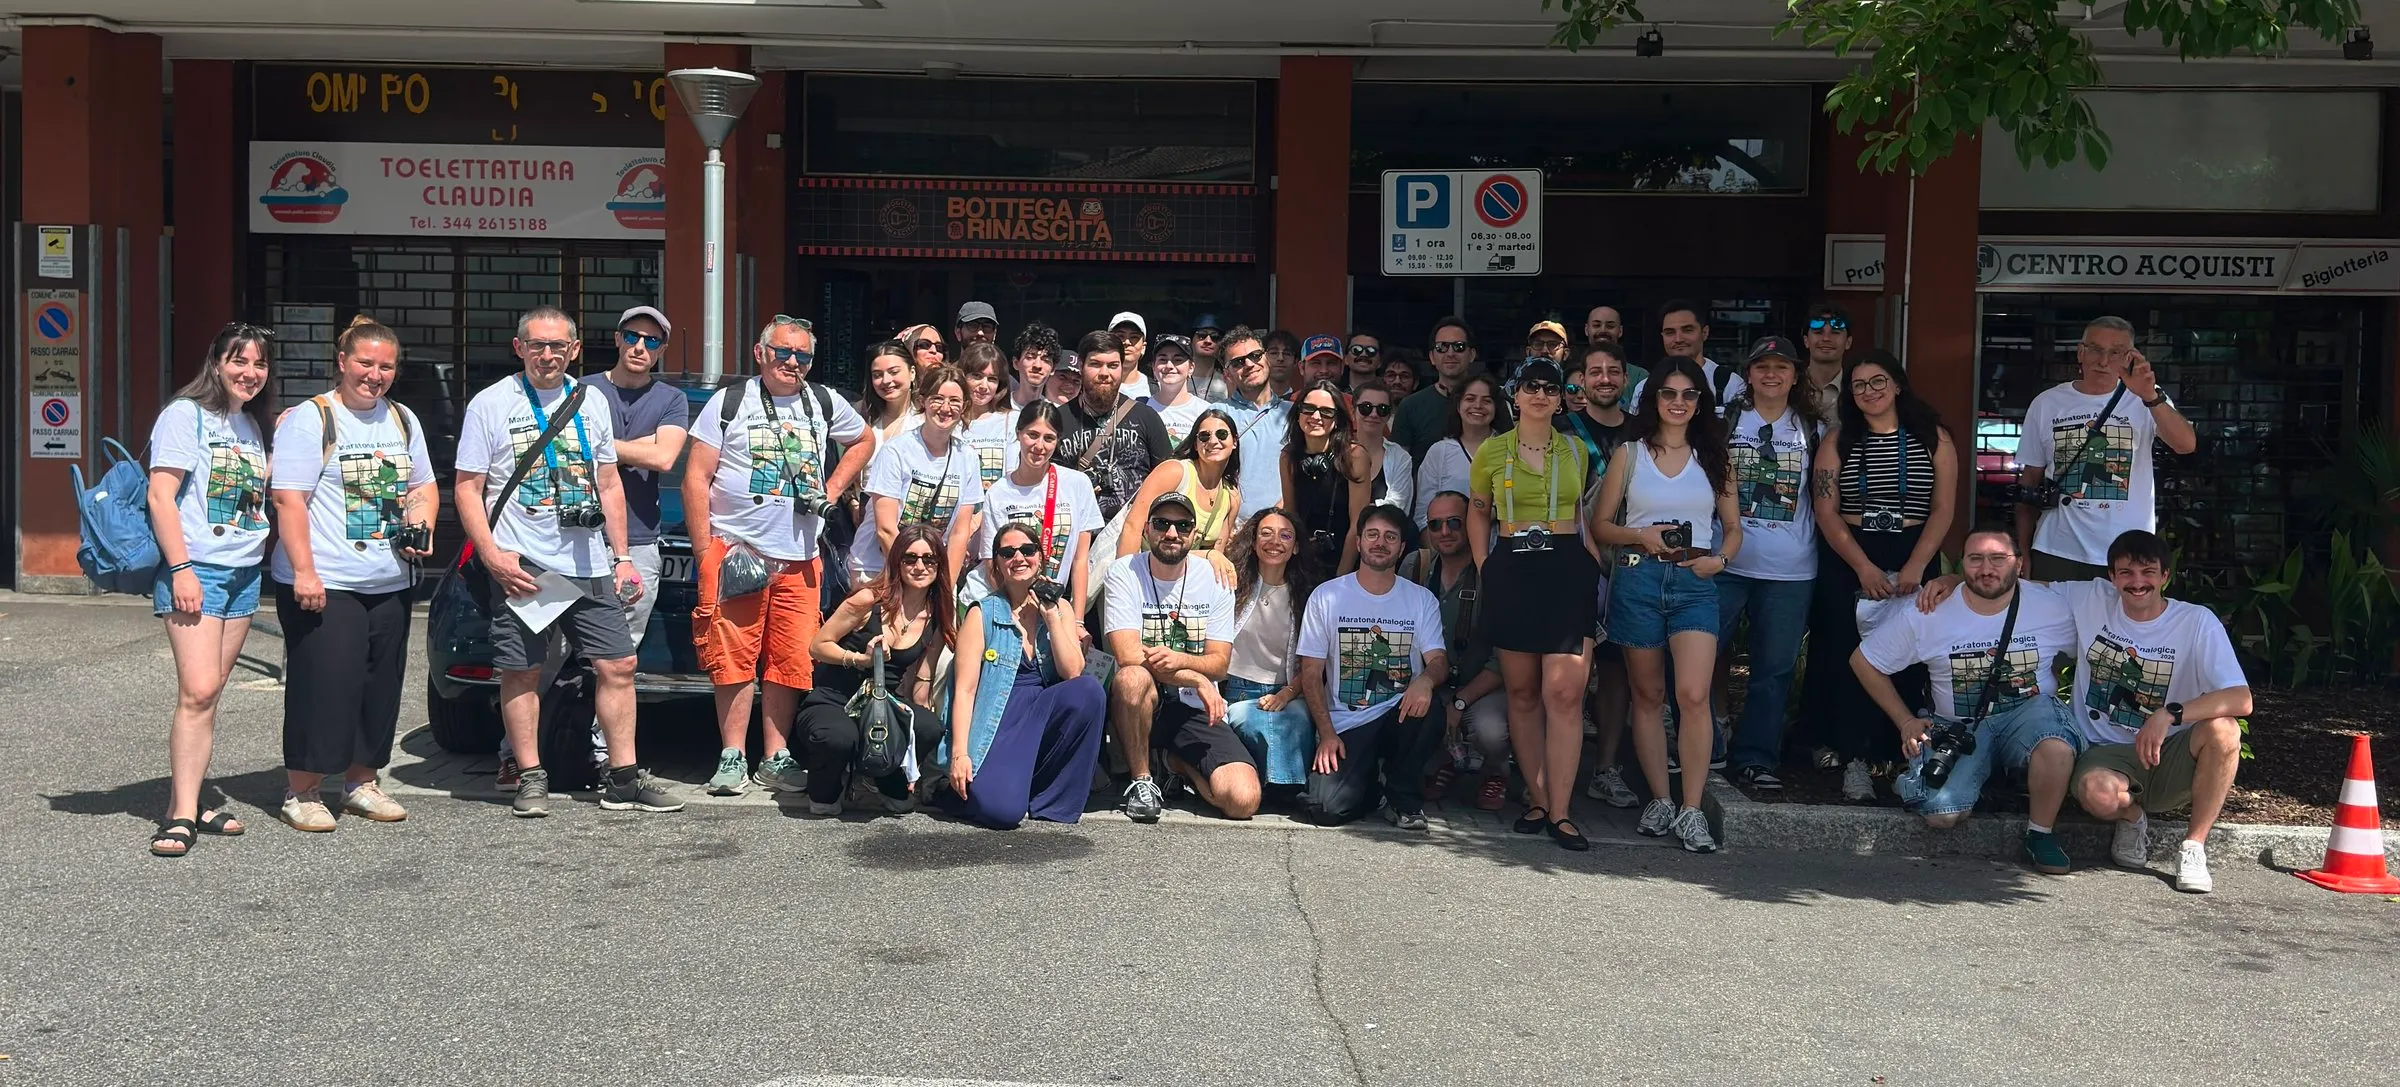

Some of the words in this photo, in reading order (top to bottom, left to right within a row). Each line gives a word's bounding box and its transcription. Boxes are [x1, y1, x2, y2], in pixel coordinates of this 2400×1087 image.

[380, 157, 574, 181] TOELETTATURA
[422, 185, 534, 207] CLAUDIA
[947, 196, 1074, 220] BOTTEGA
[410, 216, 436, 229] Tel.
[442, 216, 473, 230] 344
[478, 217, 548, 231] 2615188
[967, 218, 1113, 242] RINASCITA
[1471, 232, 1497, 240] 06.30
[1505, 232, 1531, 240] 08.00
[1415, 238, 1420, 248] 1
[1427, 240, 1446, 248] ora
[2006, 253, 2128, 276] CENTRO
[2134, 254, 2275, 280] ACQUISTI
[2302, 249, 2389, 288] Bigiotteria
[30, 346, 51, 356] PASSO
[52, 346, 80, 356] CARRAIO
[508, 414, 550, 424] Marata
[747, 414, 787, 422] Marana
[2052, 413, 2092, 425] Maratona
[32, 428, 53, 436] PASSO
[53, 428, 80, 436] CARRAIO
[1770, 440, 1803, 449] nalogica
[1047, 472, 1057, 499] Canon
[660, 557, 693, 580] DY
[1338, 615, 1376, 625] Maratona
[1376, 617, 1416, 627] Analogica
[1951, 640, 1992, 653] Maratona
[1994, 634, 2037, 647] Alogica
[2135, 644, 2177, 655] Analogica
